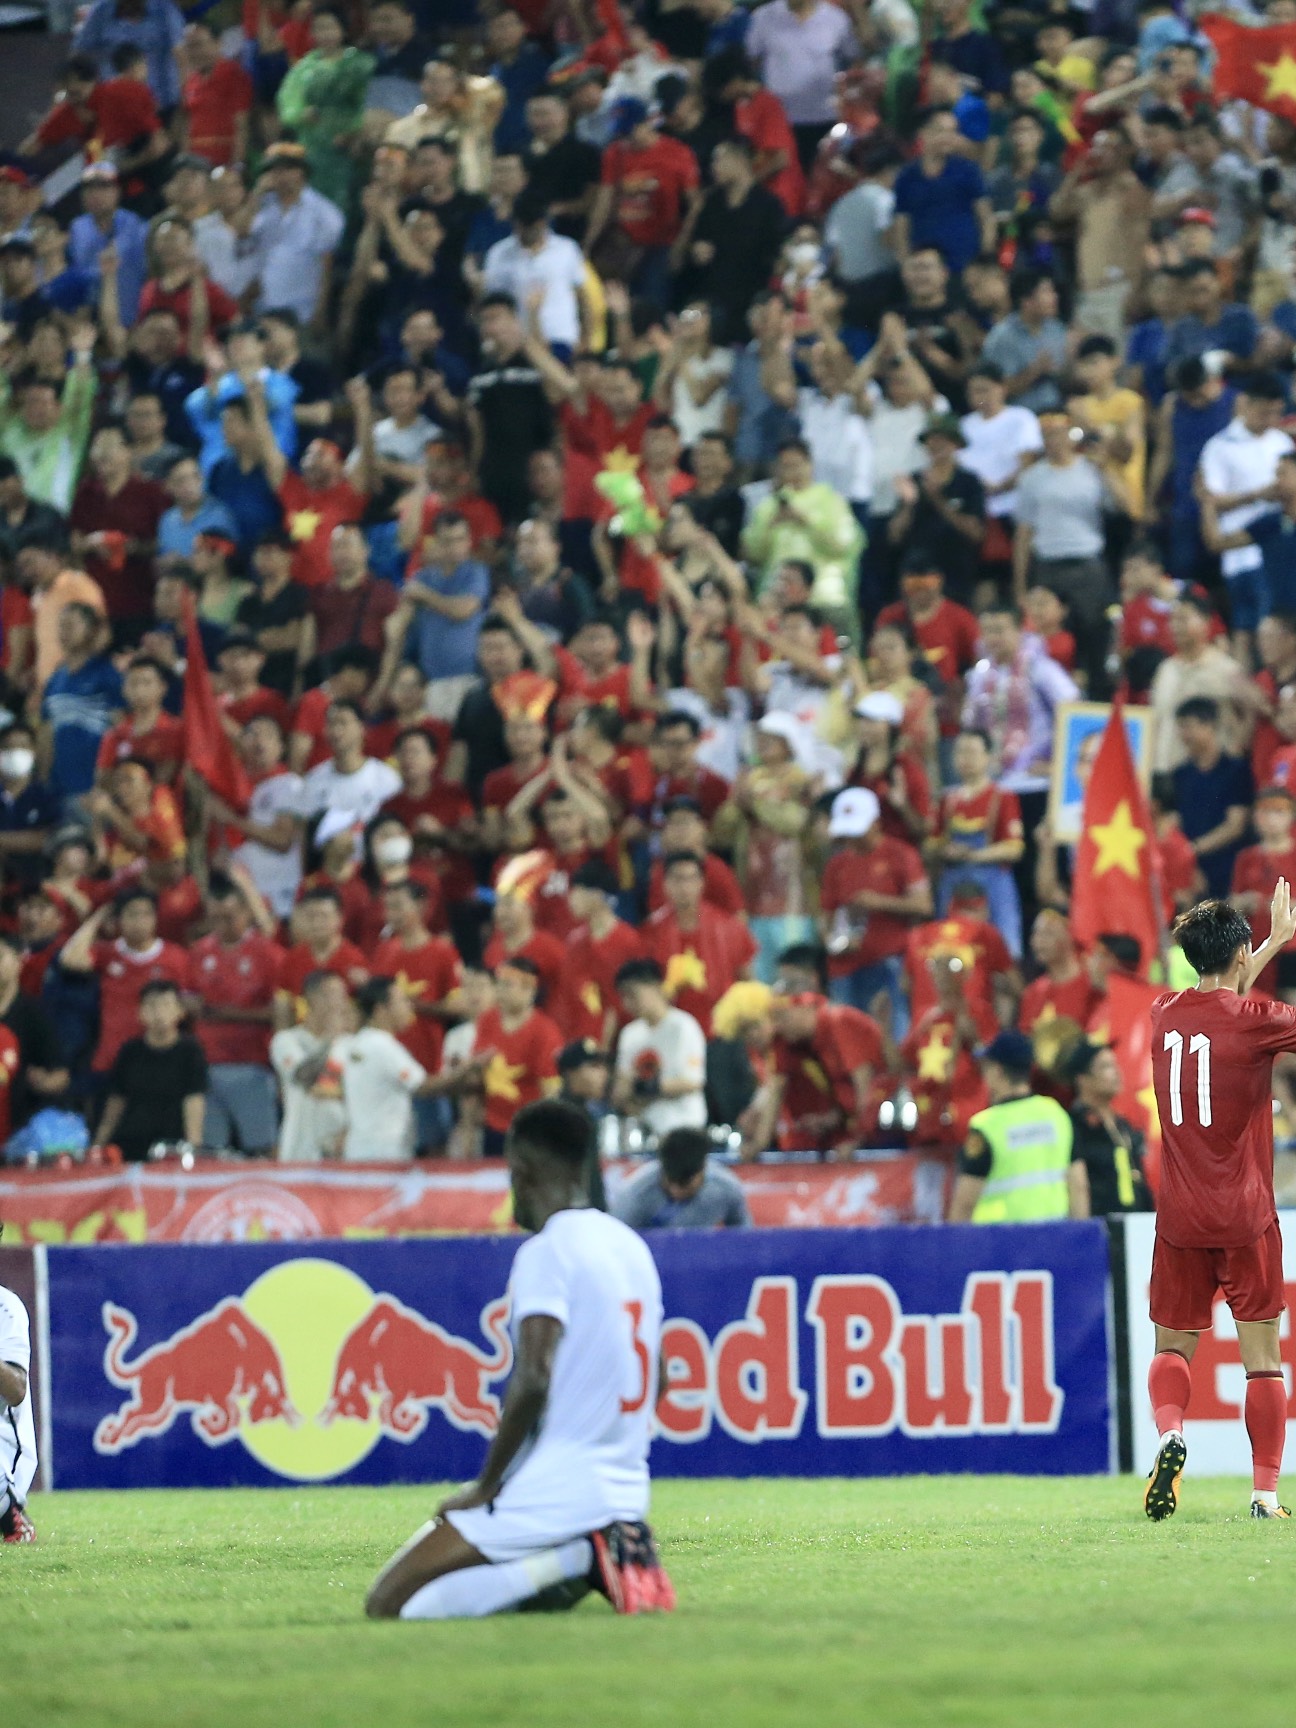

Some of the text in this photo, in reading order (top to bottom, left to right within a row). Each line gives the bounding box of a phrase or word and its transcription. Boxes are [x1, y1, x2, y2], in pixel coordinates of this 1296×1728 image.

[1163, 1029, 1212, 1128] 11
[652, 1270, 1065, 1443] ed Bull
